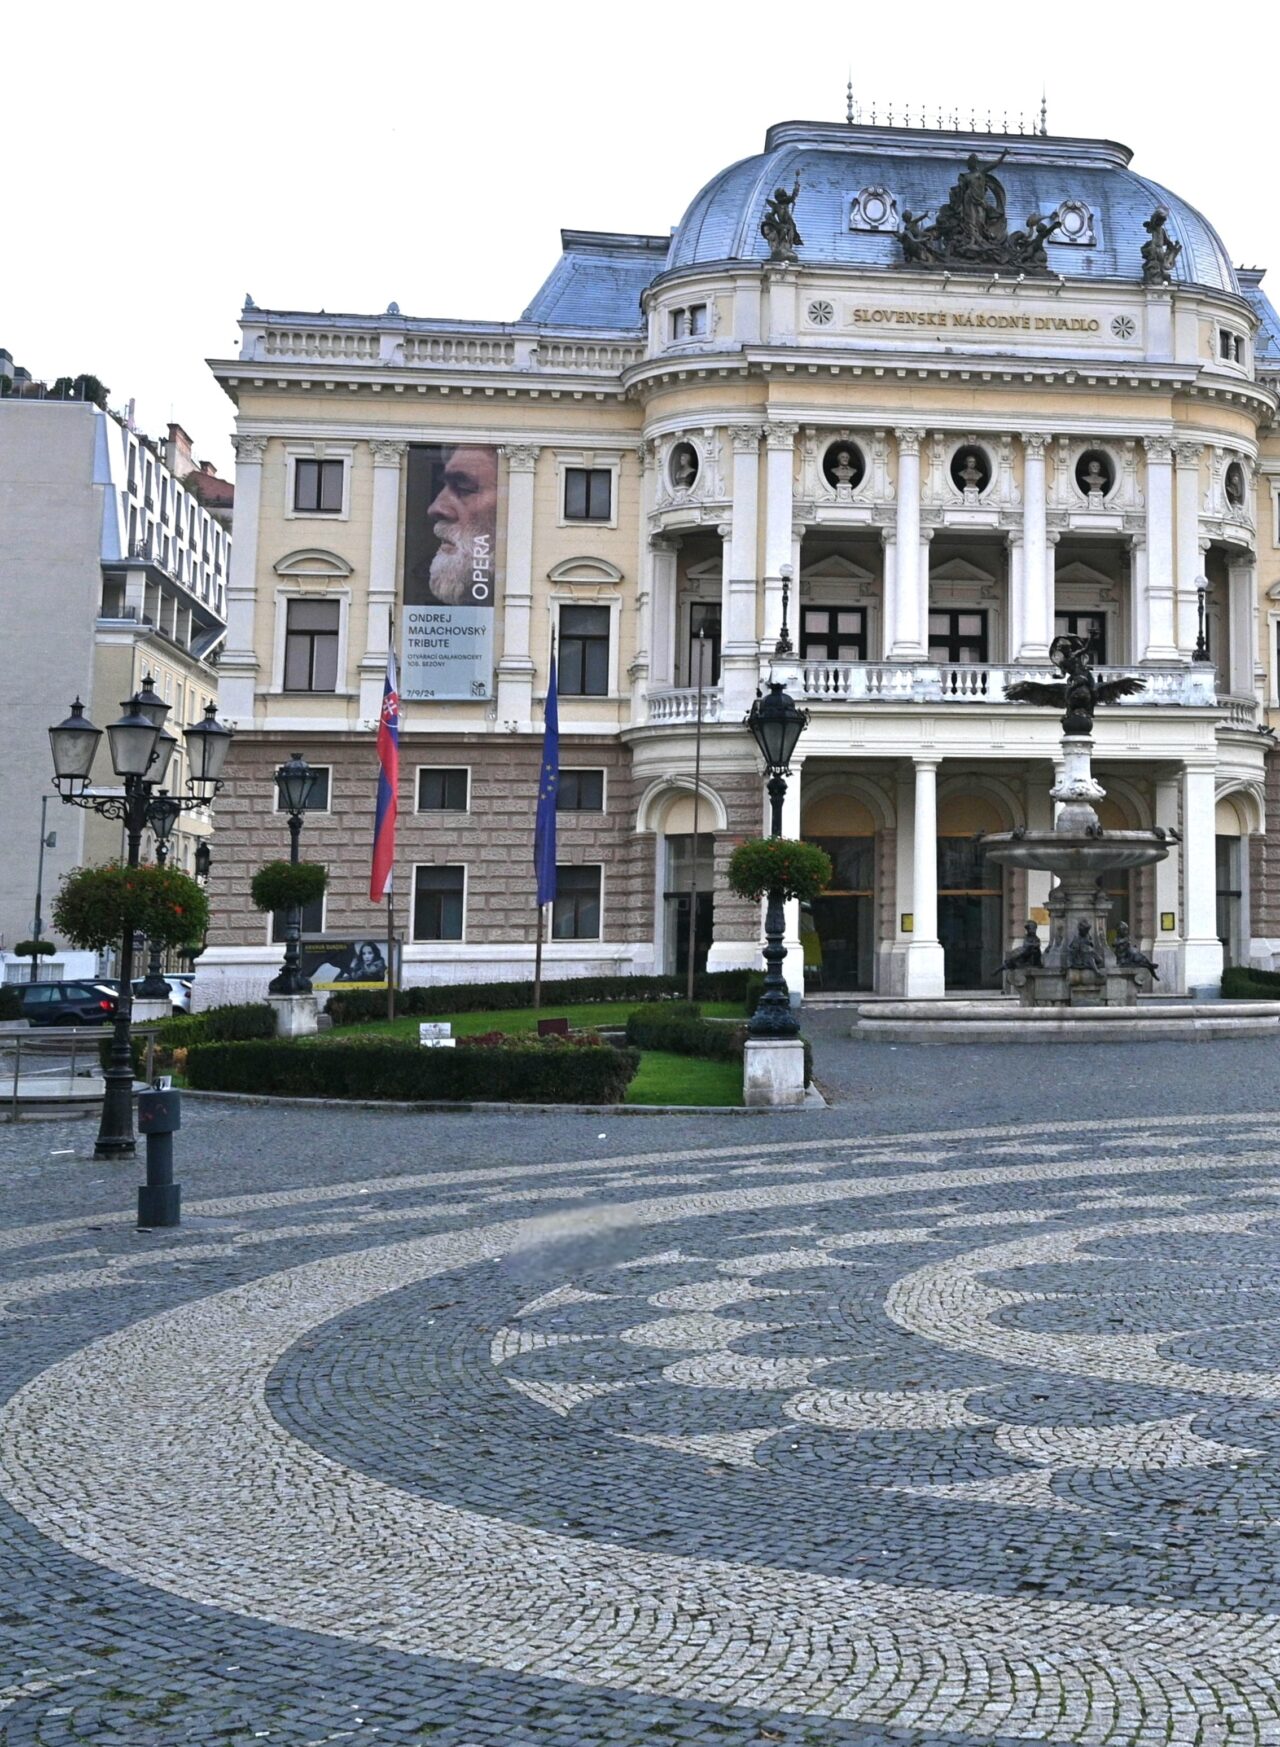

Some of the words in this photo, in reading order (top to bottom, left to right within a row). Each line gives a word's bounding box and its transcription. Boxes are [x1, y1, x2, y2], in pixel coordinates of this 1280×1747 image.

[853, 308, 947, 327] SLOVENSKÉ
[952, 309, 1031, 329] NÁRODNÉ
[1034, 317, 1100, 332] DIVADLO
[472, 534, 490, 600] OPERA
[408, 613, 452, 623] ONDREJ
[408, 625, 487, 636] MALACHOVSKÝ
[407, 638, 450, 648] TRIBUTE
[407, 689, 435, 697] 7/9/24
